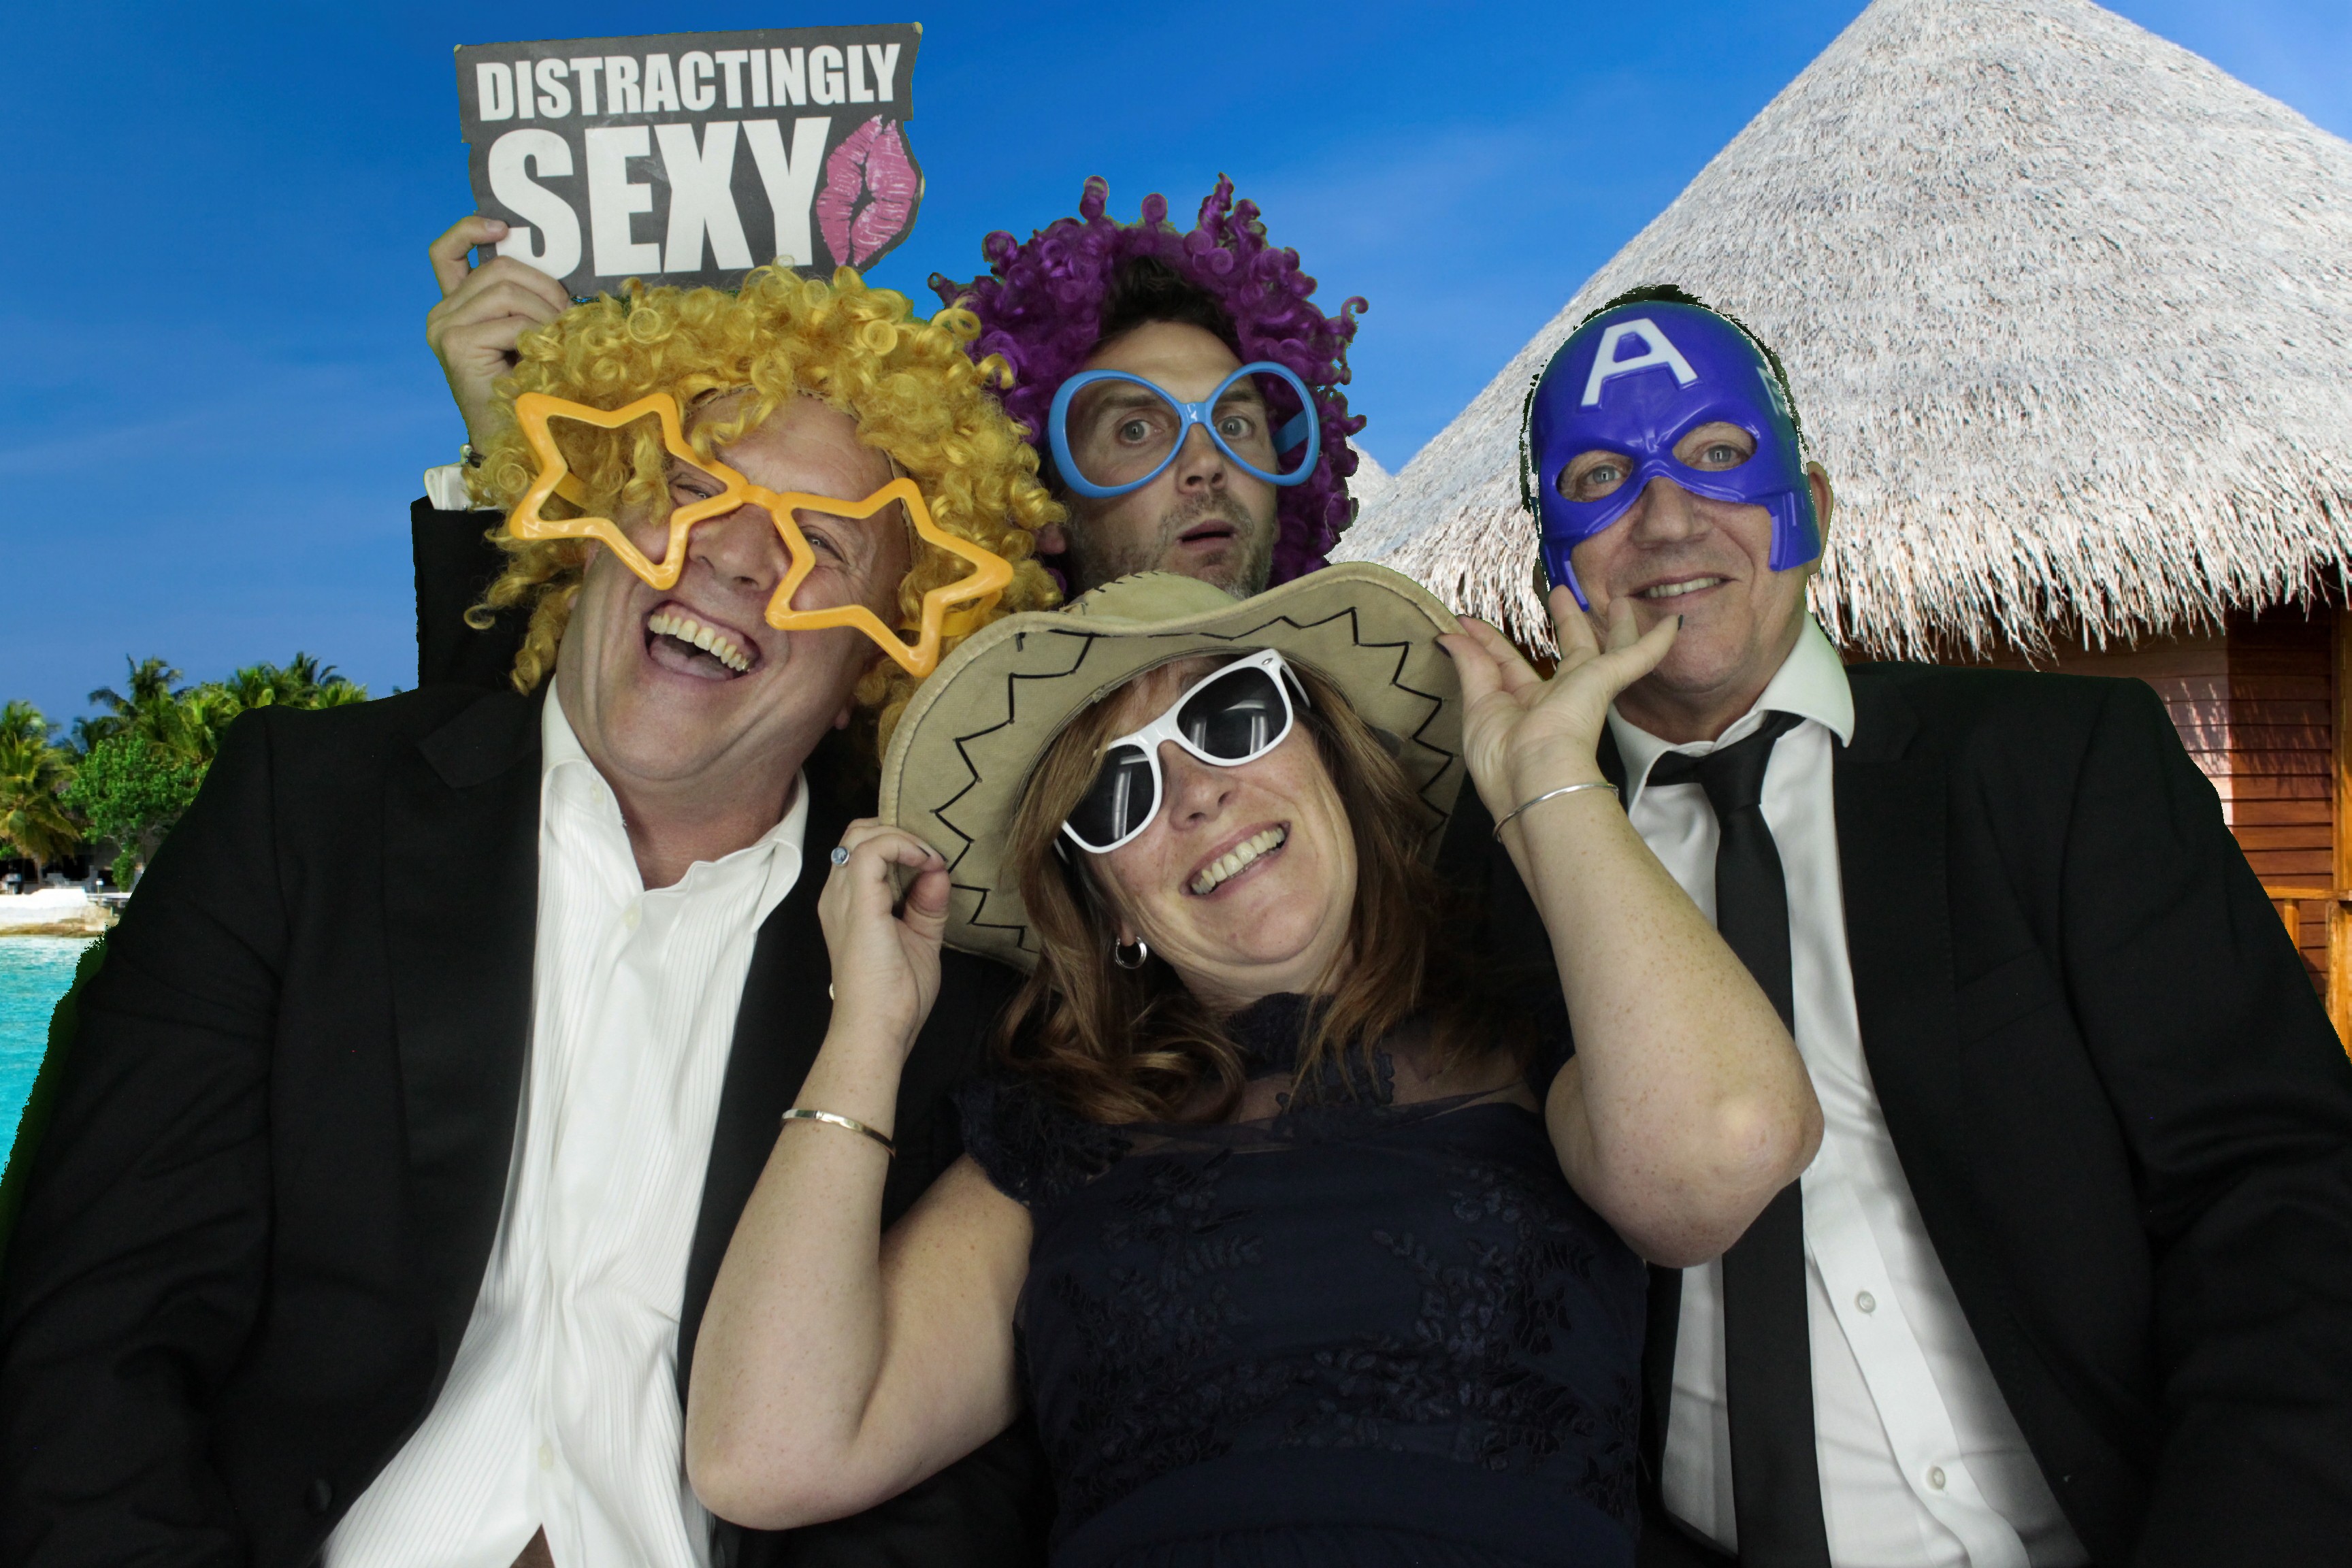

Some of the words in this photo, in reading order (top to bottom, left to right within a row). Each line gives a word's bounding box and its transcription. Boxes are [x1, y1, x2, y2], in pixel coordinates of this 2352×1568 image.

[476, 44, 901, 121] DISTRACTINGLY
[489, 116, 831, 280] SEXY
[1581, 318, 1698, 407] A
